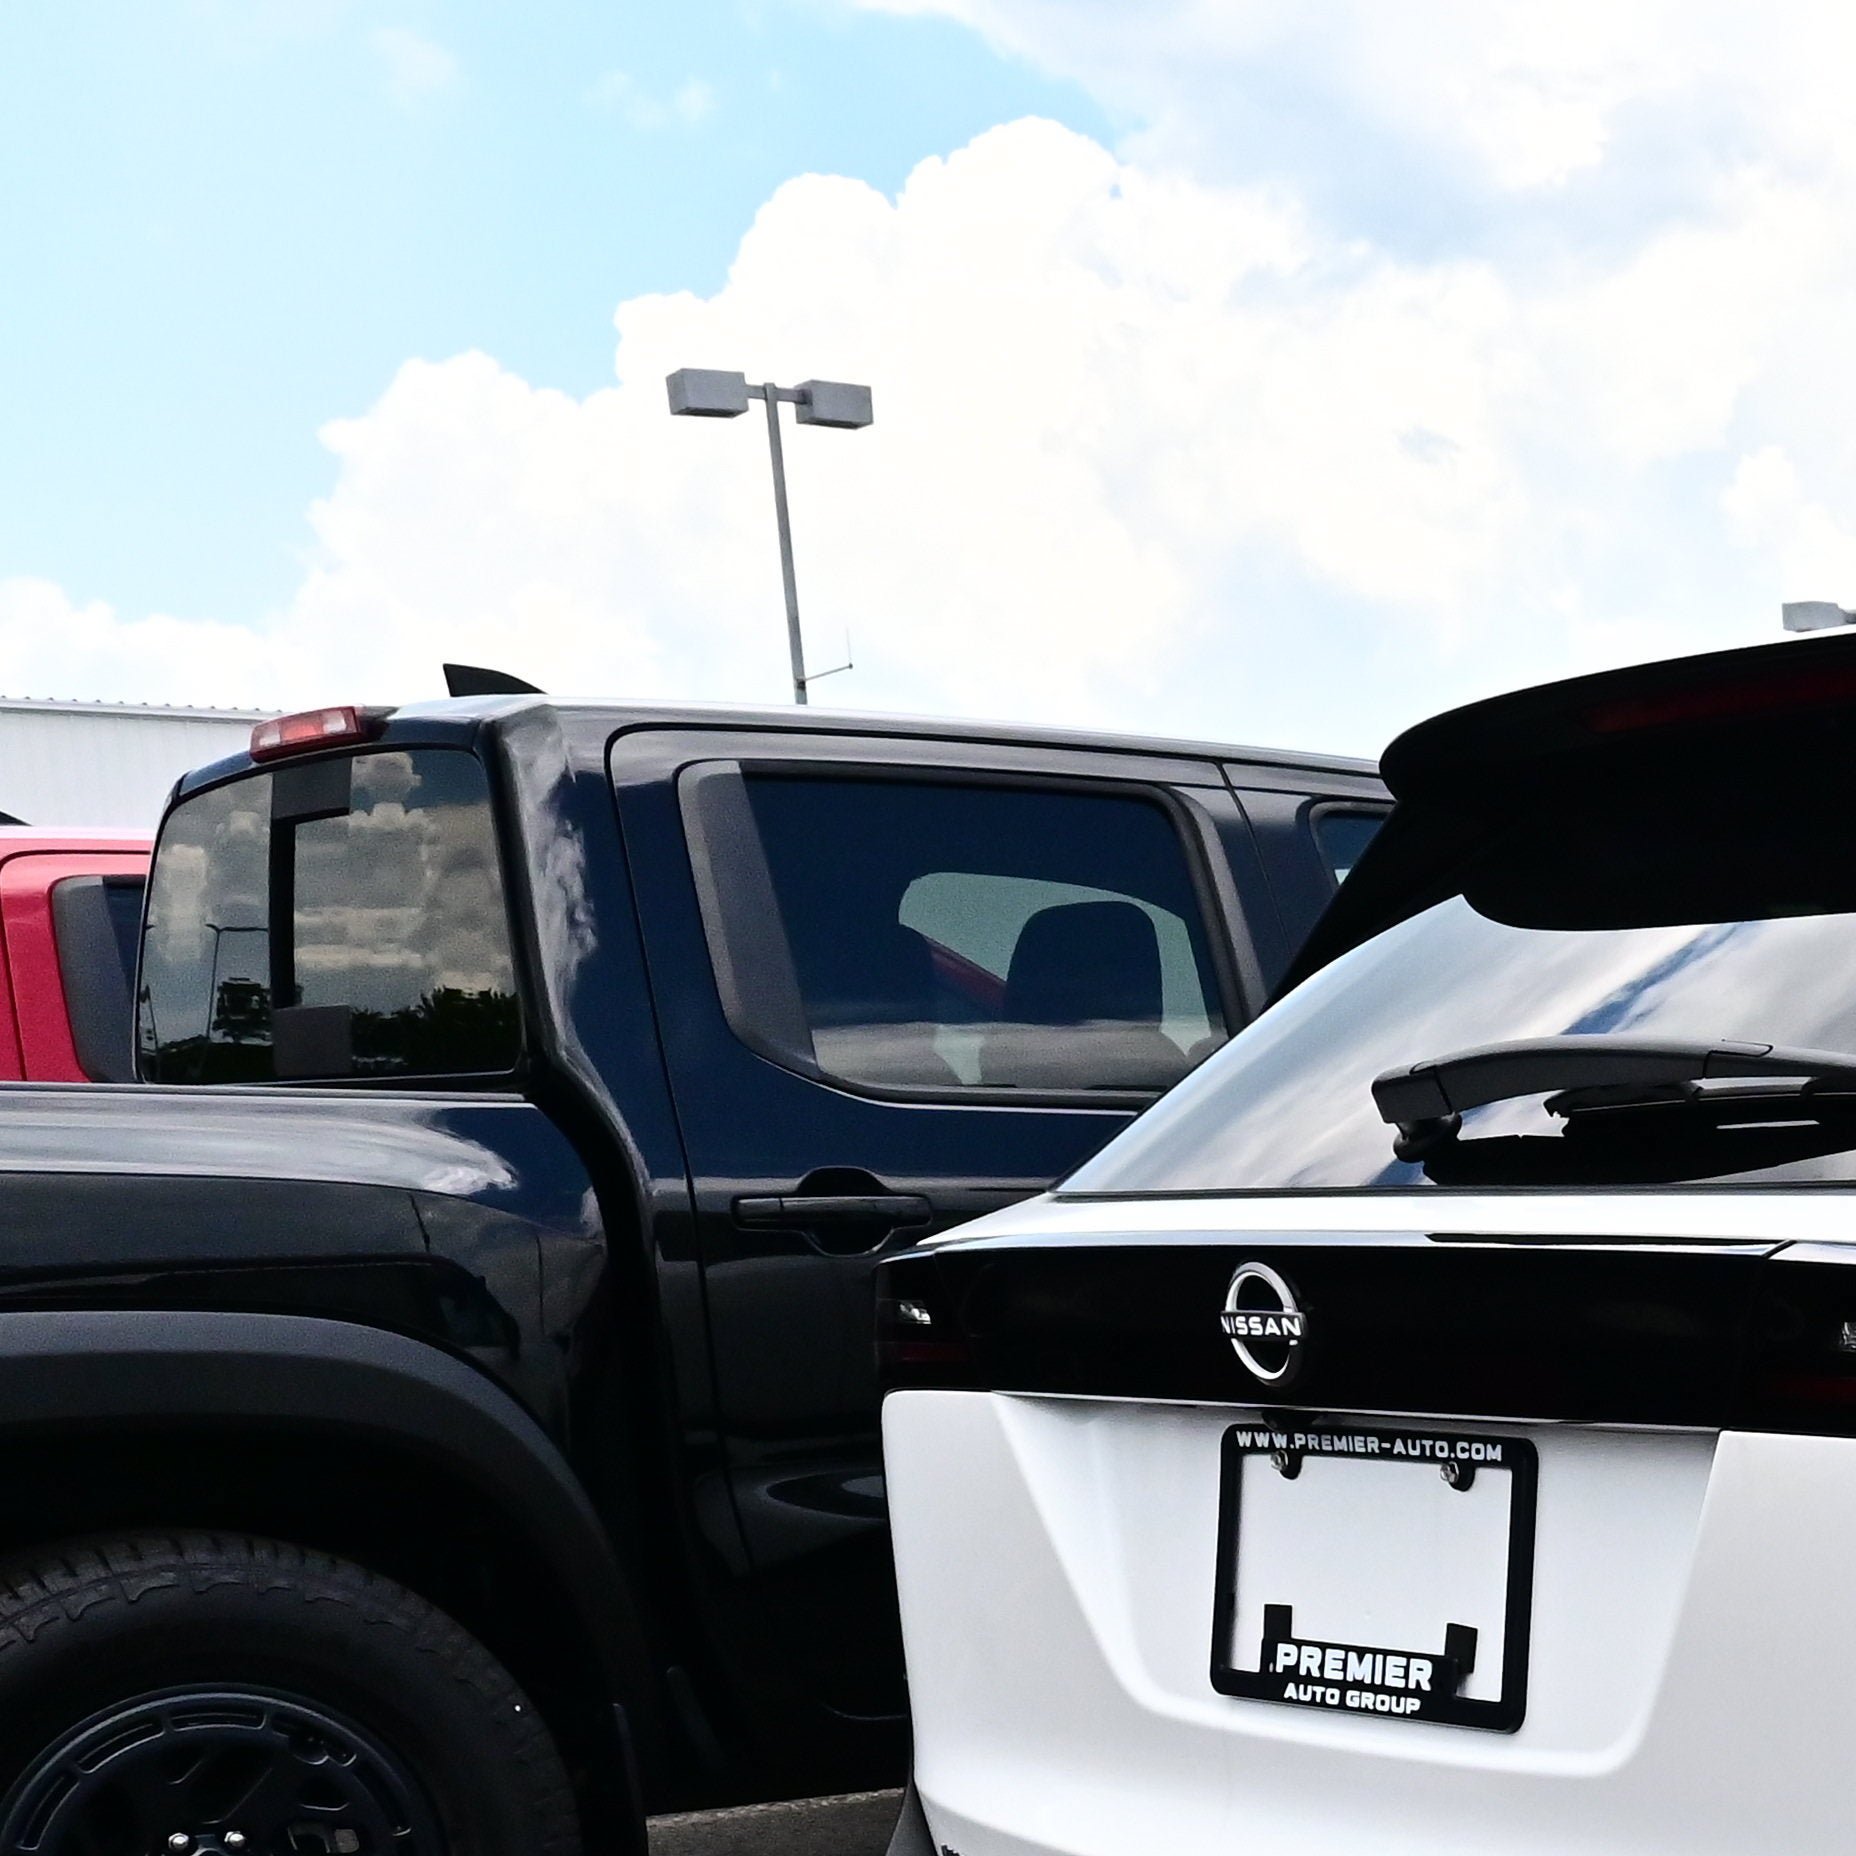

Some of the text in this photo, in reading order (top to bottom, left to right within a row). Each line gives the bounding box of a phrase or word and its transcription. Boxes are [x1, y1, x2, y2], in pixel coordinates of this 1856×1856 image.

[1220, 1314, 1301, 1338] NISSAN
[1235, 1430, 1503, 1462] WWW.PREMIER-AUTO.COM
[1275, 1642, 1433, 1692] PREMIER
[1283, 1682, 1421, 1716] AUTO GROUP
